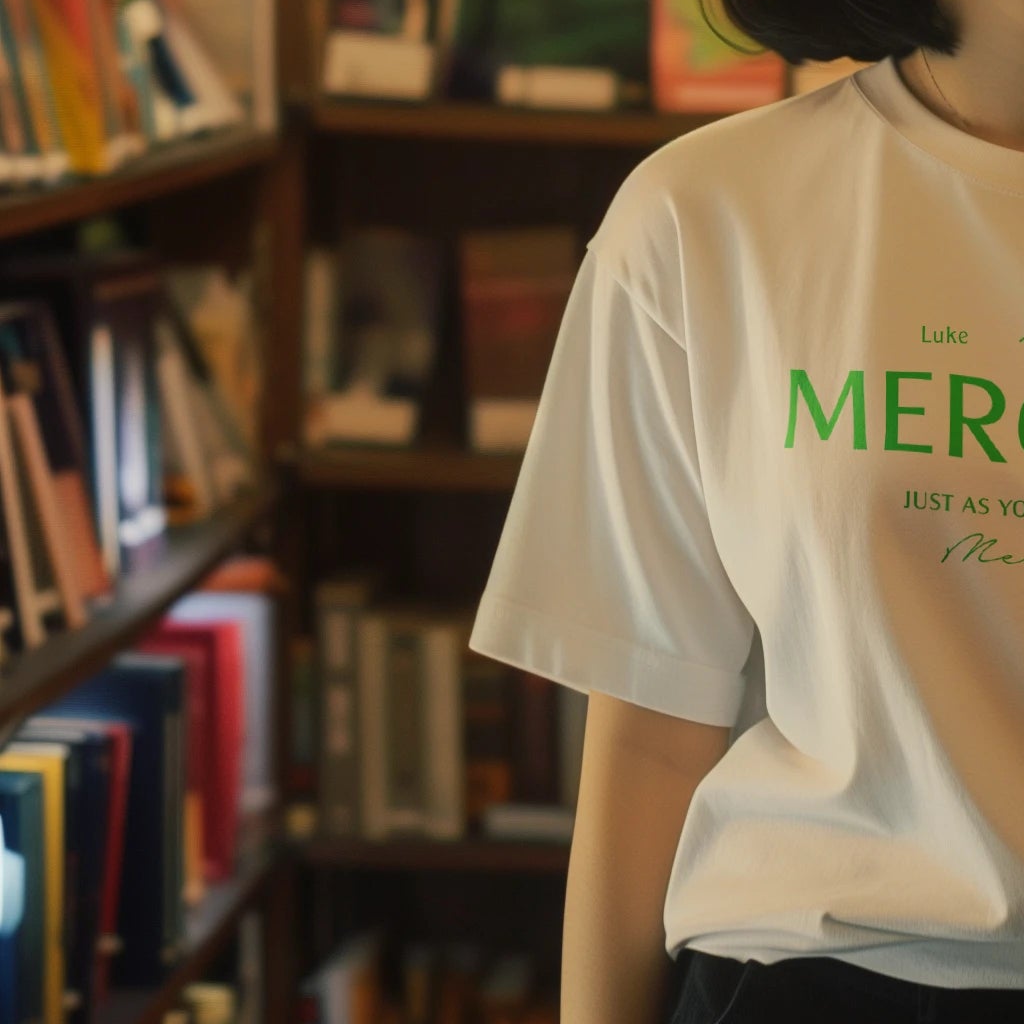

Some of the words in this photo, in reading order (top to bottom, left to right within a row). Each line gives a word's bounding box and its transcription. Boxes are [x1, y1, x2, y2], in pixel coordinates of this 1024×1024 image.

[921, 325, 969, 345] Luke
[903, 490, 954, 513] JUST
[962, 496, 991, 515] AS
